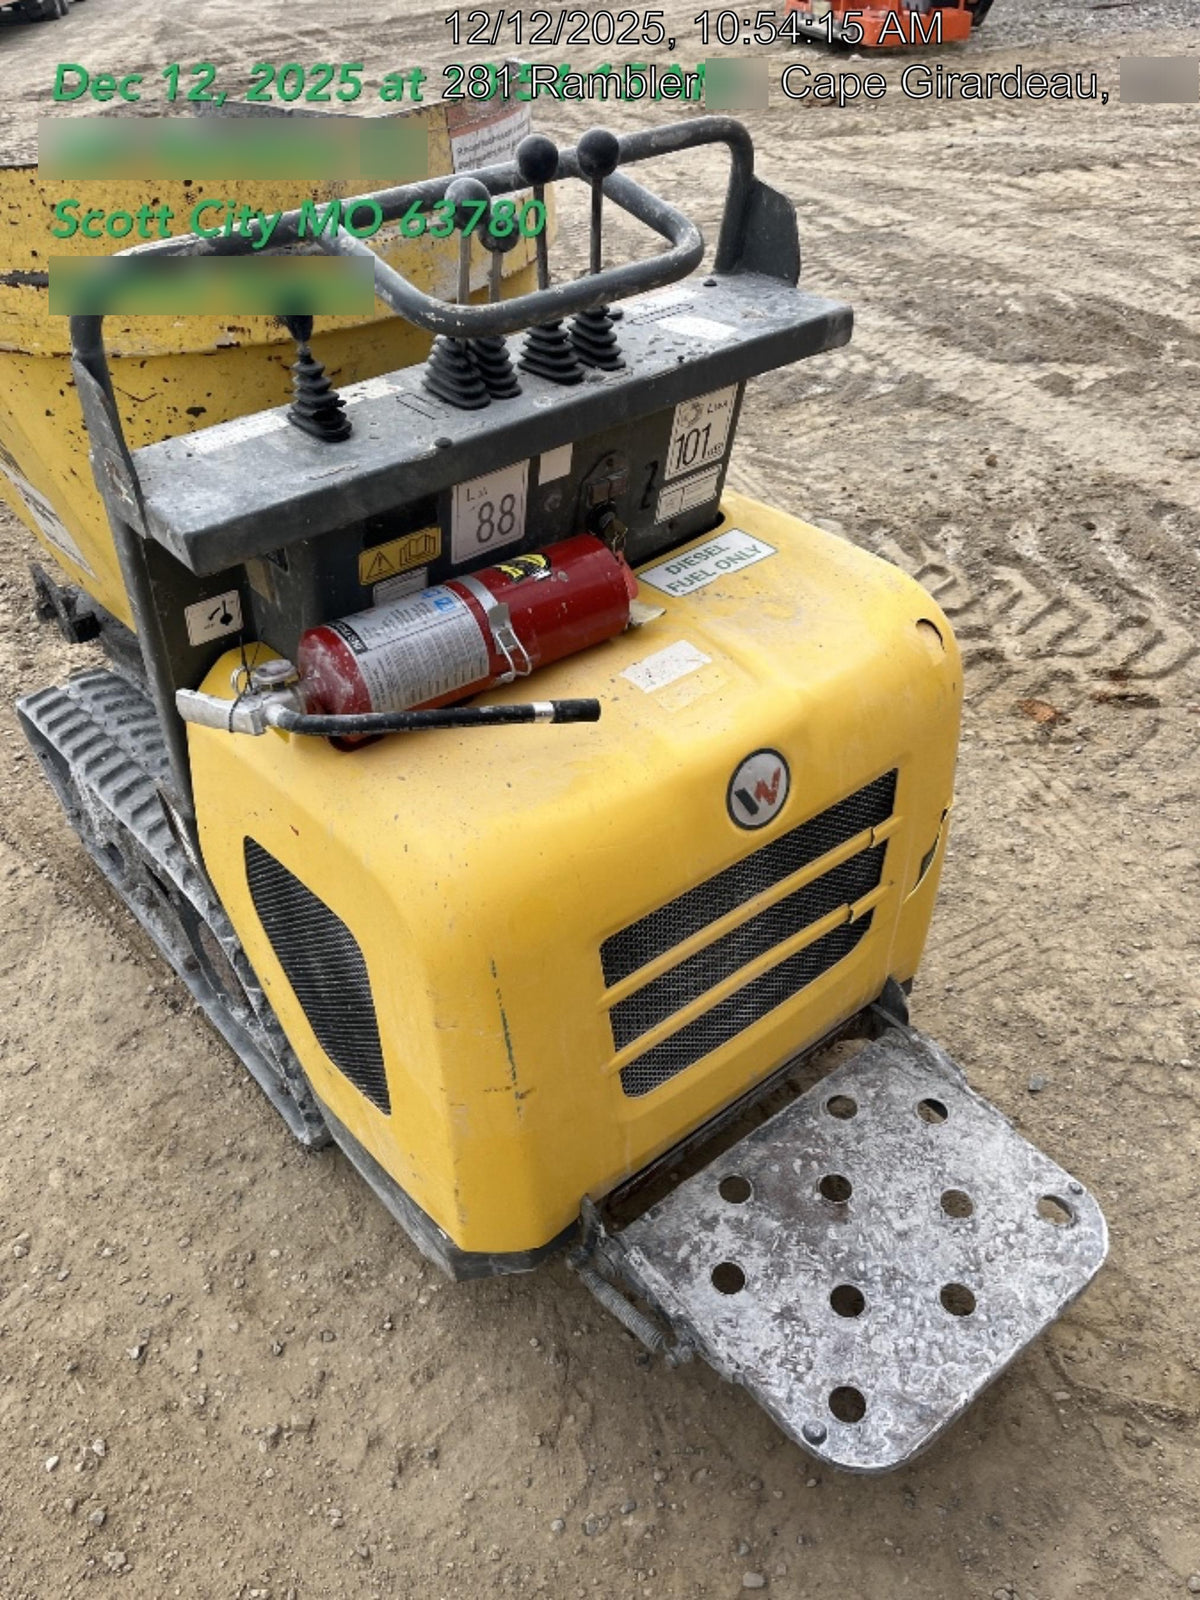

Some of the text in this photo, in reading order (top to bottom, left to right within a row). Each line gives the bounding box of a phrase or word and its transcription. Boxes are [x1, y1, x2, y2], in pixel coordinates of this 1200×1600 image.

[675, 422, 712, 469] 101
[477, 494, 515, 543] 88
[665, 543, 730, 575] DIESEL
[666, 544, 762, 592] FUEL ONLY
